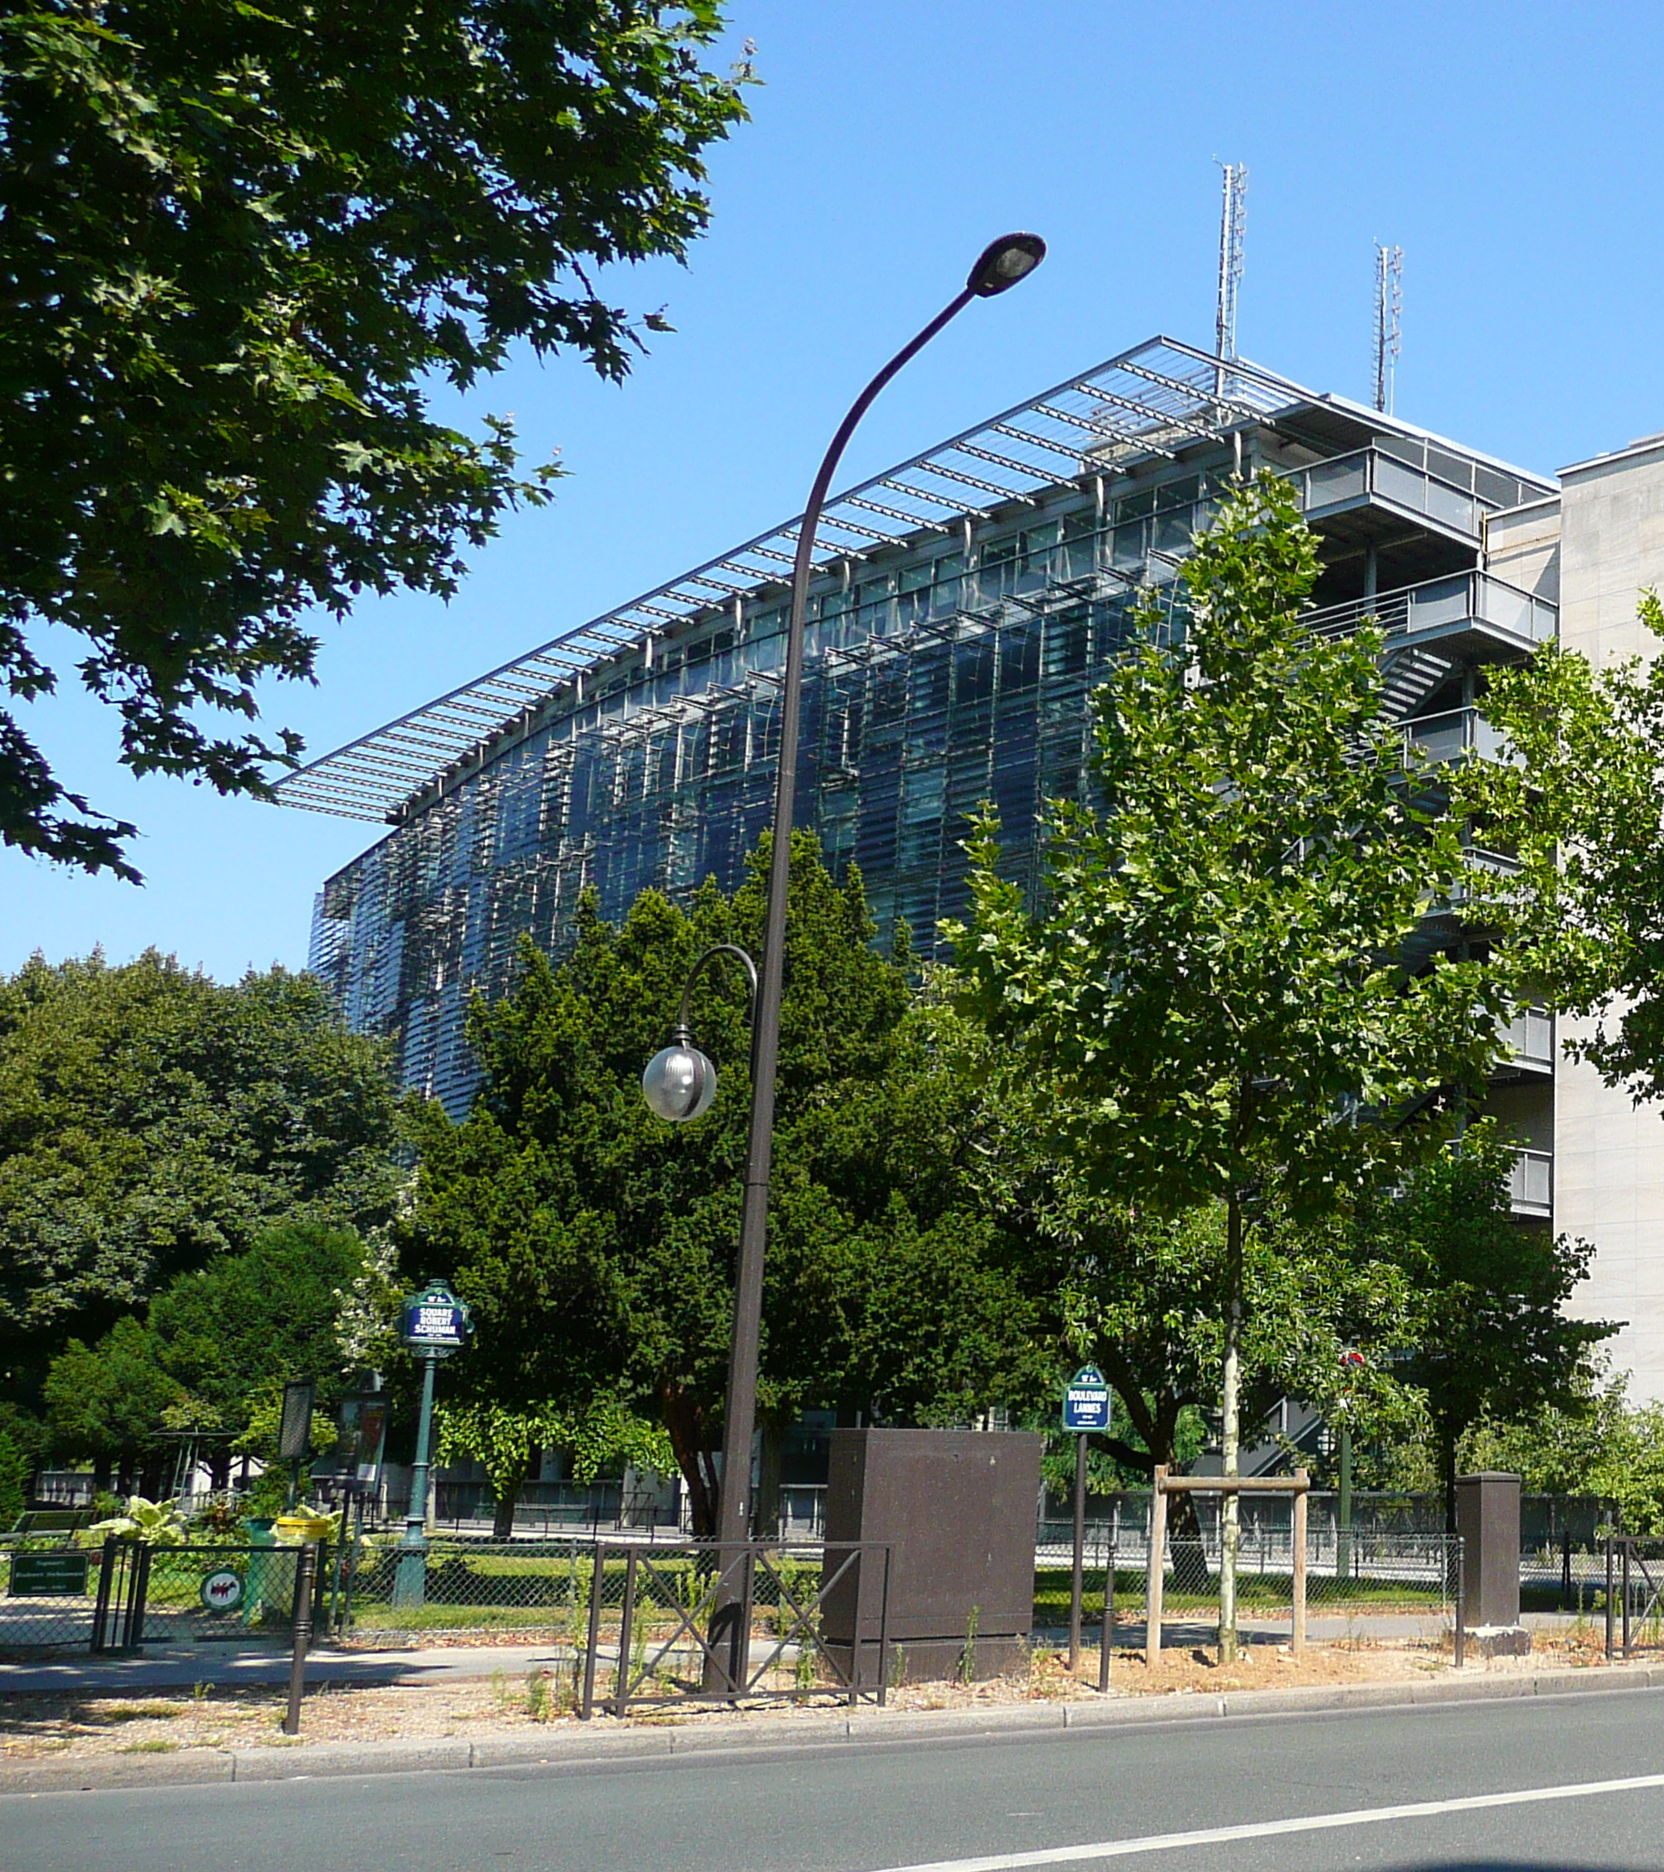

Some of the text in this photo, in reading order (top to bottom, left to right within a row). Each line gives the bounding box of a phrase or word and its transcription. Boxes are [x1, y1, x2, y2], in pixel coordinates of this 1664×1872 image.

[419, 1308, 453, 1317] SQUARE
[420, 1316, 452, 1325] ROBERT
[414, 1324, 456, 1334] SCHUMAN
[1068, 1390, 1107, 1402] BOULEVARD
[1073, 1402, 1101, 1414] LANNES
